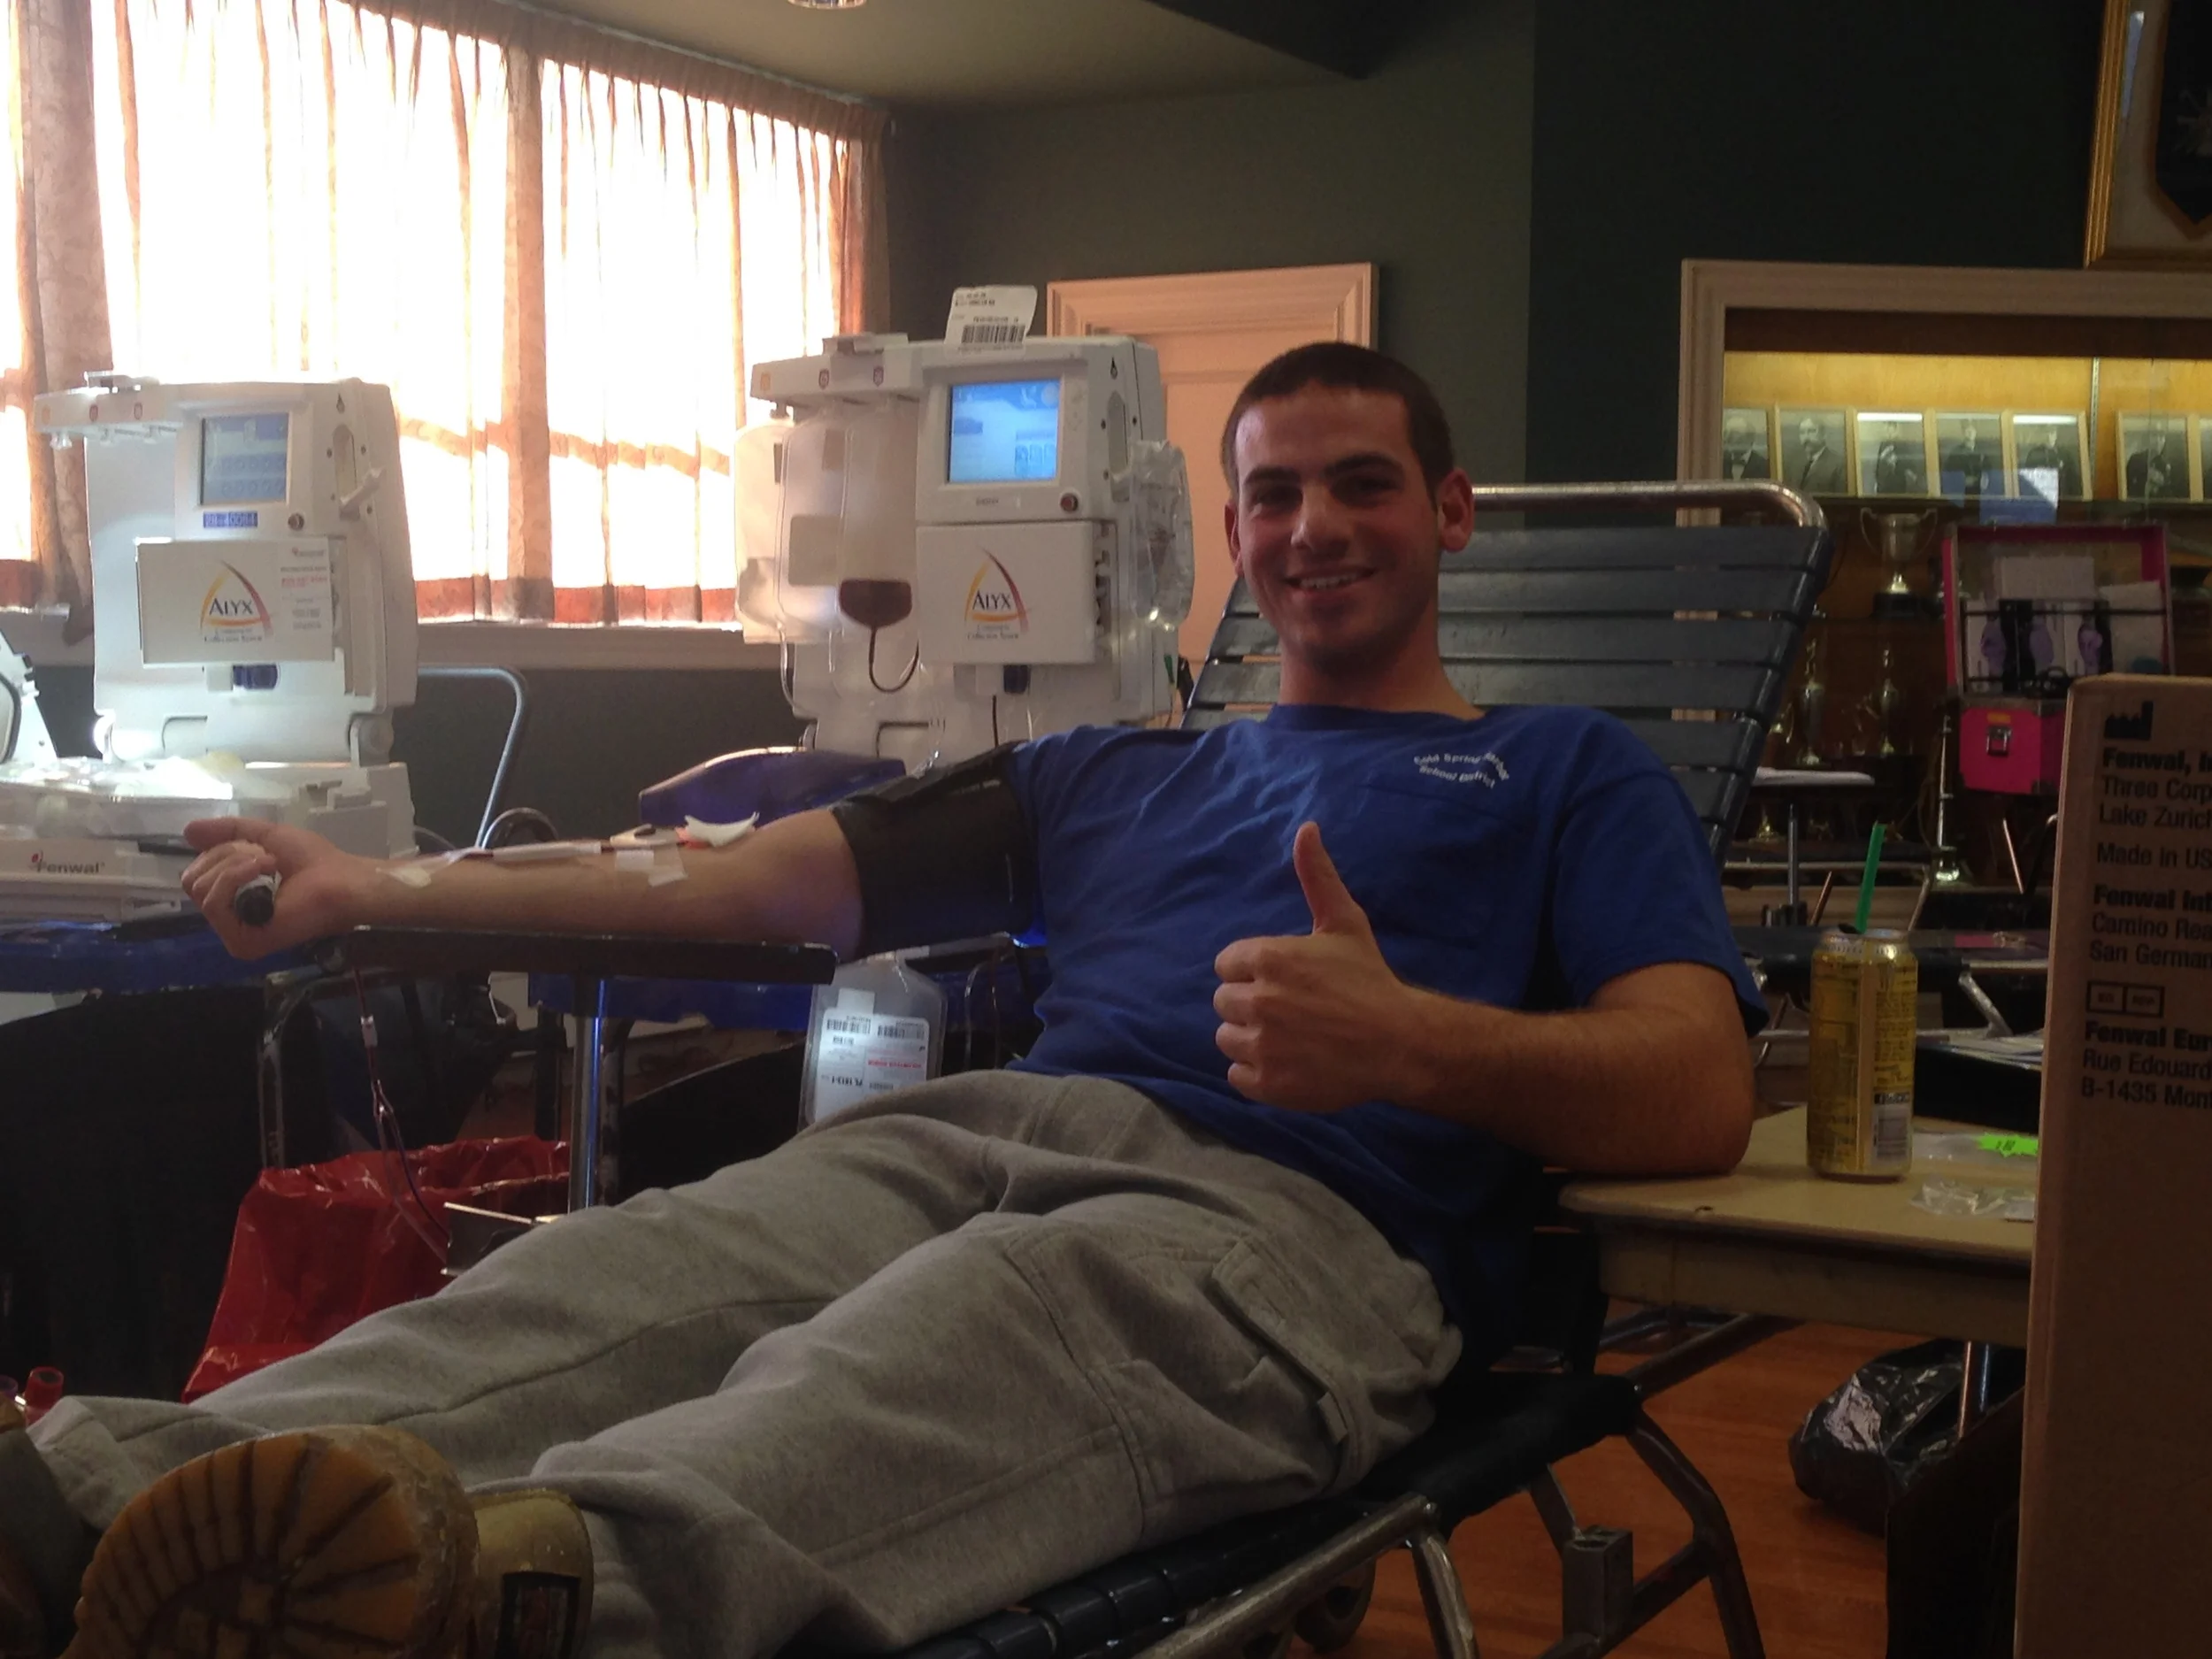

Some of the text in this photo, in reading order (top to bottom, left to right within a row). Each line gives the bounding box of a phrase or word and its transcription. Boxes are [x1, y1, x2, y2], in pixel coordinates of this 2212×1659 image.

[2103, 747, 2191, 776] Fenwal,
[2102, 775, 2158, 798] Three
[2100, 803, 2147, 827] Lake
[2097, 842, 2153, 865] Made
[2160, 846, 2177, 867] in
[2093, 883, 2176, 910] Fenwal
[2092, 913, 2169, 939] Camino
[2090, 940, 2128, 963] San
[2085, 1020, 2167, 1048] Fenwal
[2083, 1048, 2212, 1080] Rue Edouard
[2081, 1076, 2157, 1102] B-1435
